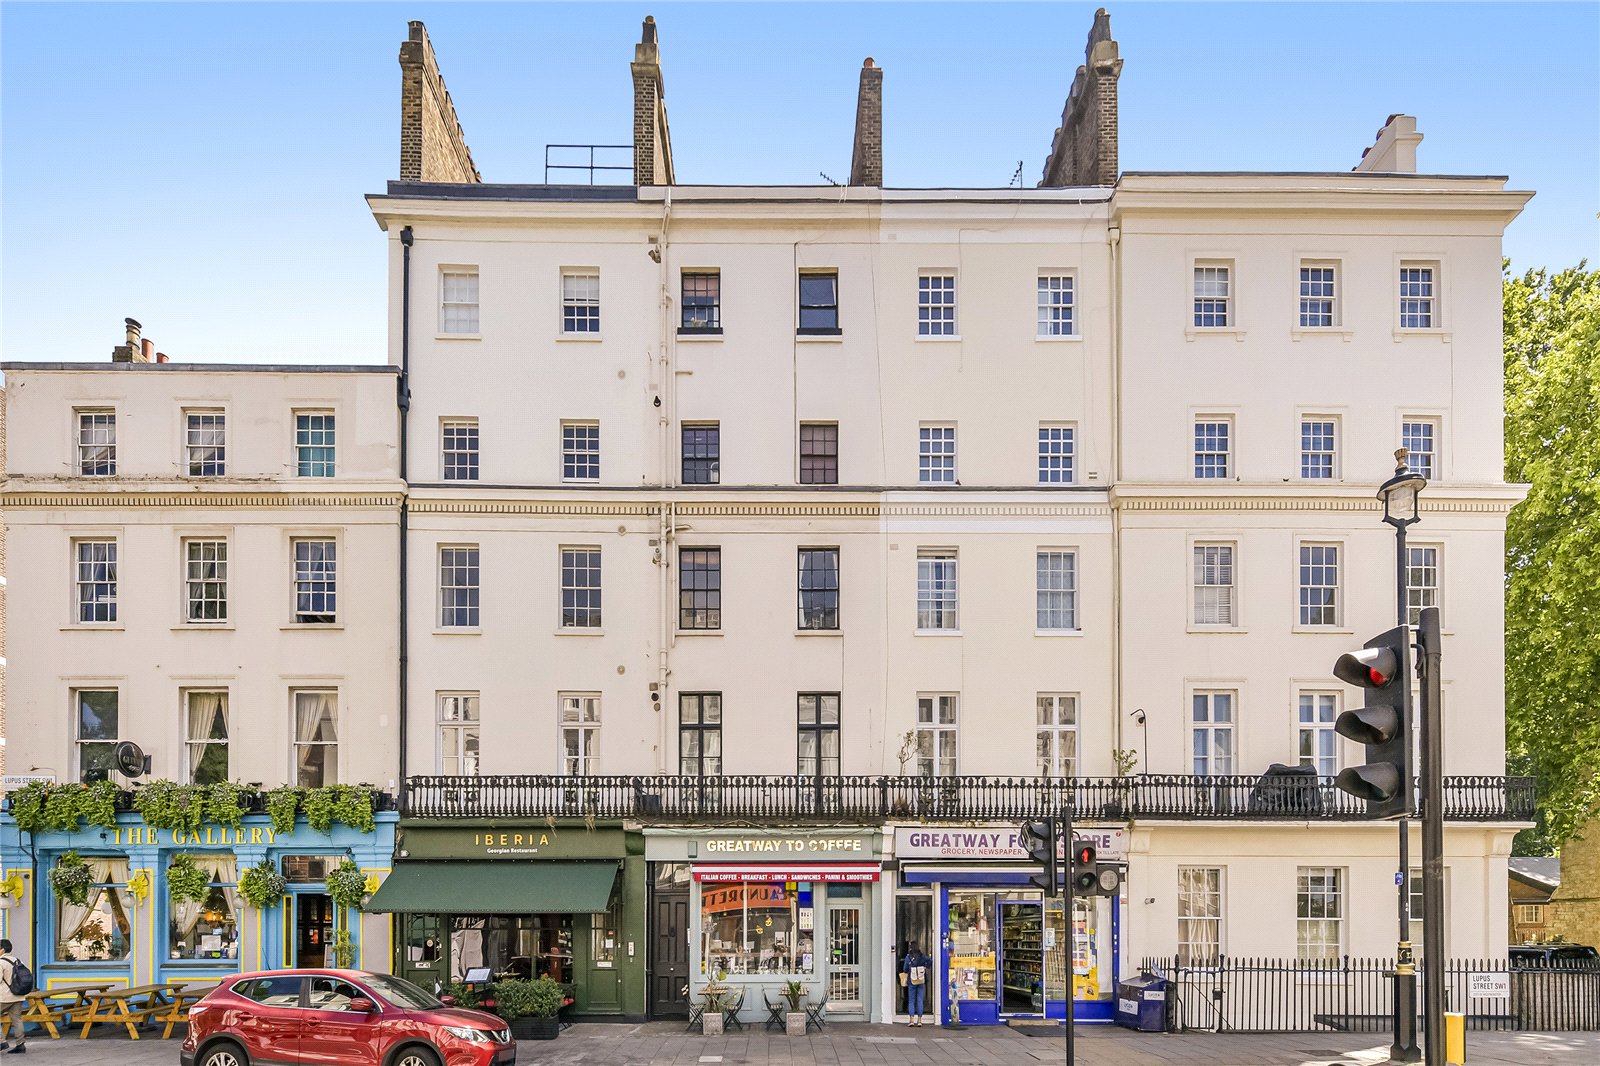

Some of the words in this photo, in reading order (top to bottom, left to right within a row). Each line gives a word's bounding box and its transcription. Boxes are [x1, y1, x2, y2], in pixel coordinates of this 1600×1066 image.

[112, 827, 159, 845] THE
[172, 827, 277, 845] GALLERY
[475, 834, 549, 846] IBERIA
[910, 834, 1000, 847] GREATWAY
[486, 847, 510, 855] Georgian
[706, 839, 782, 852] GREATWAY
[785, 839, 805, 852] TO
[808, 839, 862, 852] COFFEE
[941, 848, 976, 856] GROCERY,
